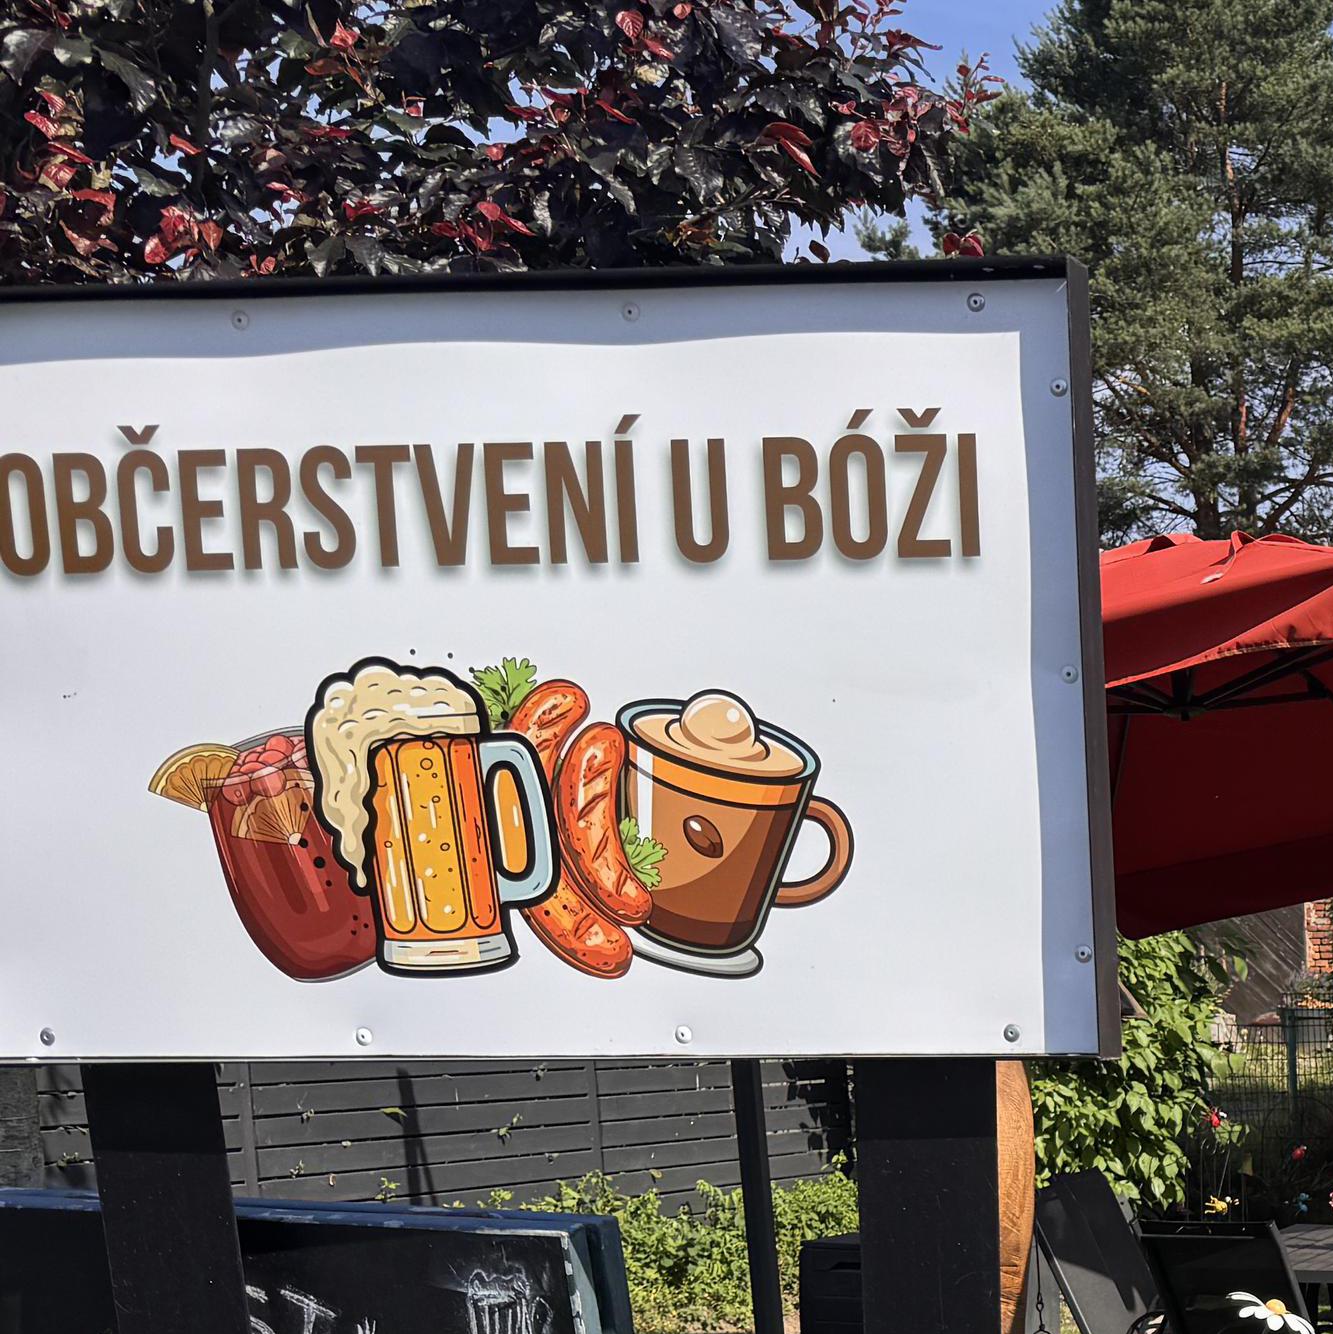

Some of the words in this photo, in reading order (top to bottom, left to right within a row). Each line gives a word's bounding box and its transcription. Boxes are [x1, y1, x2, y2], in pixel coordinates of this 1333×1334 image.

[0, 413, 642, 576] OBČERSTVENÍ
[669, 437, 731, 565] U
[761, 406, 982, 562] BÓŽI
